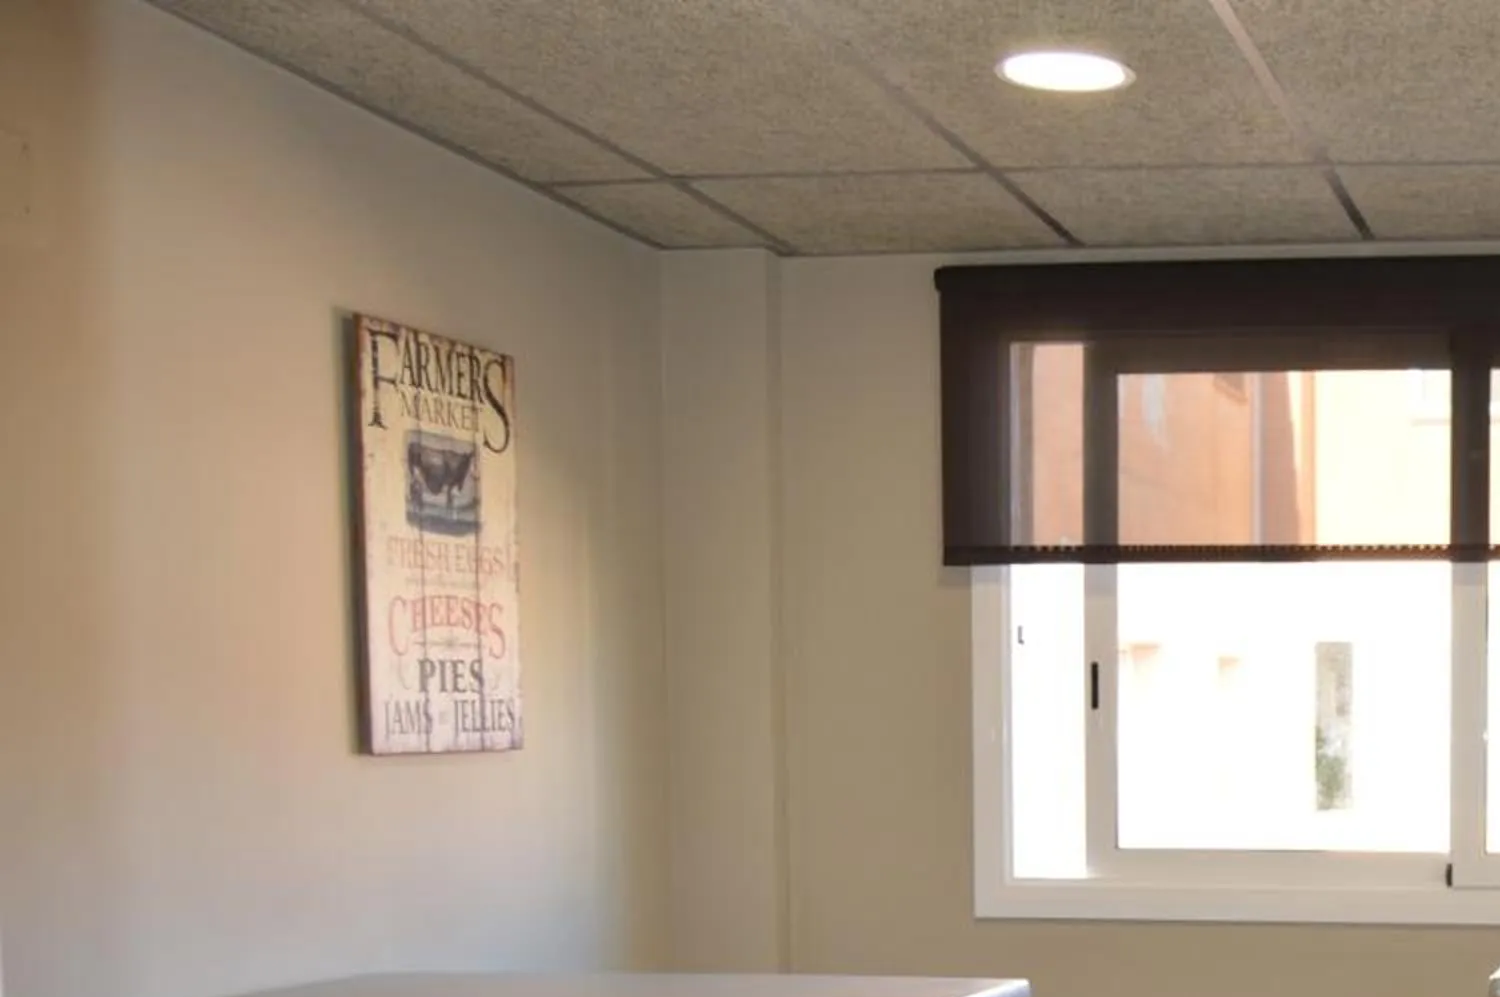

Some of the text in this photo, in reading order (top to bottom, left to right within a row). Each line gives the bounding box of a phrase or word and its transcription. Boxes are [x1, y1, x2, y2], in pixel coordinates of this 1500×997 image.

[367, 328, 510, 454] FARMERS
[400, 390, 484, 432] MARKET
[386, 536, 451, 574] FRESH
[388, 594, 507, 660] CHEESES
[416, 657, 486, 694] PIES
[384, 697, 433, 738] JAMS
[454, 699, 516, 738] JELLIES
